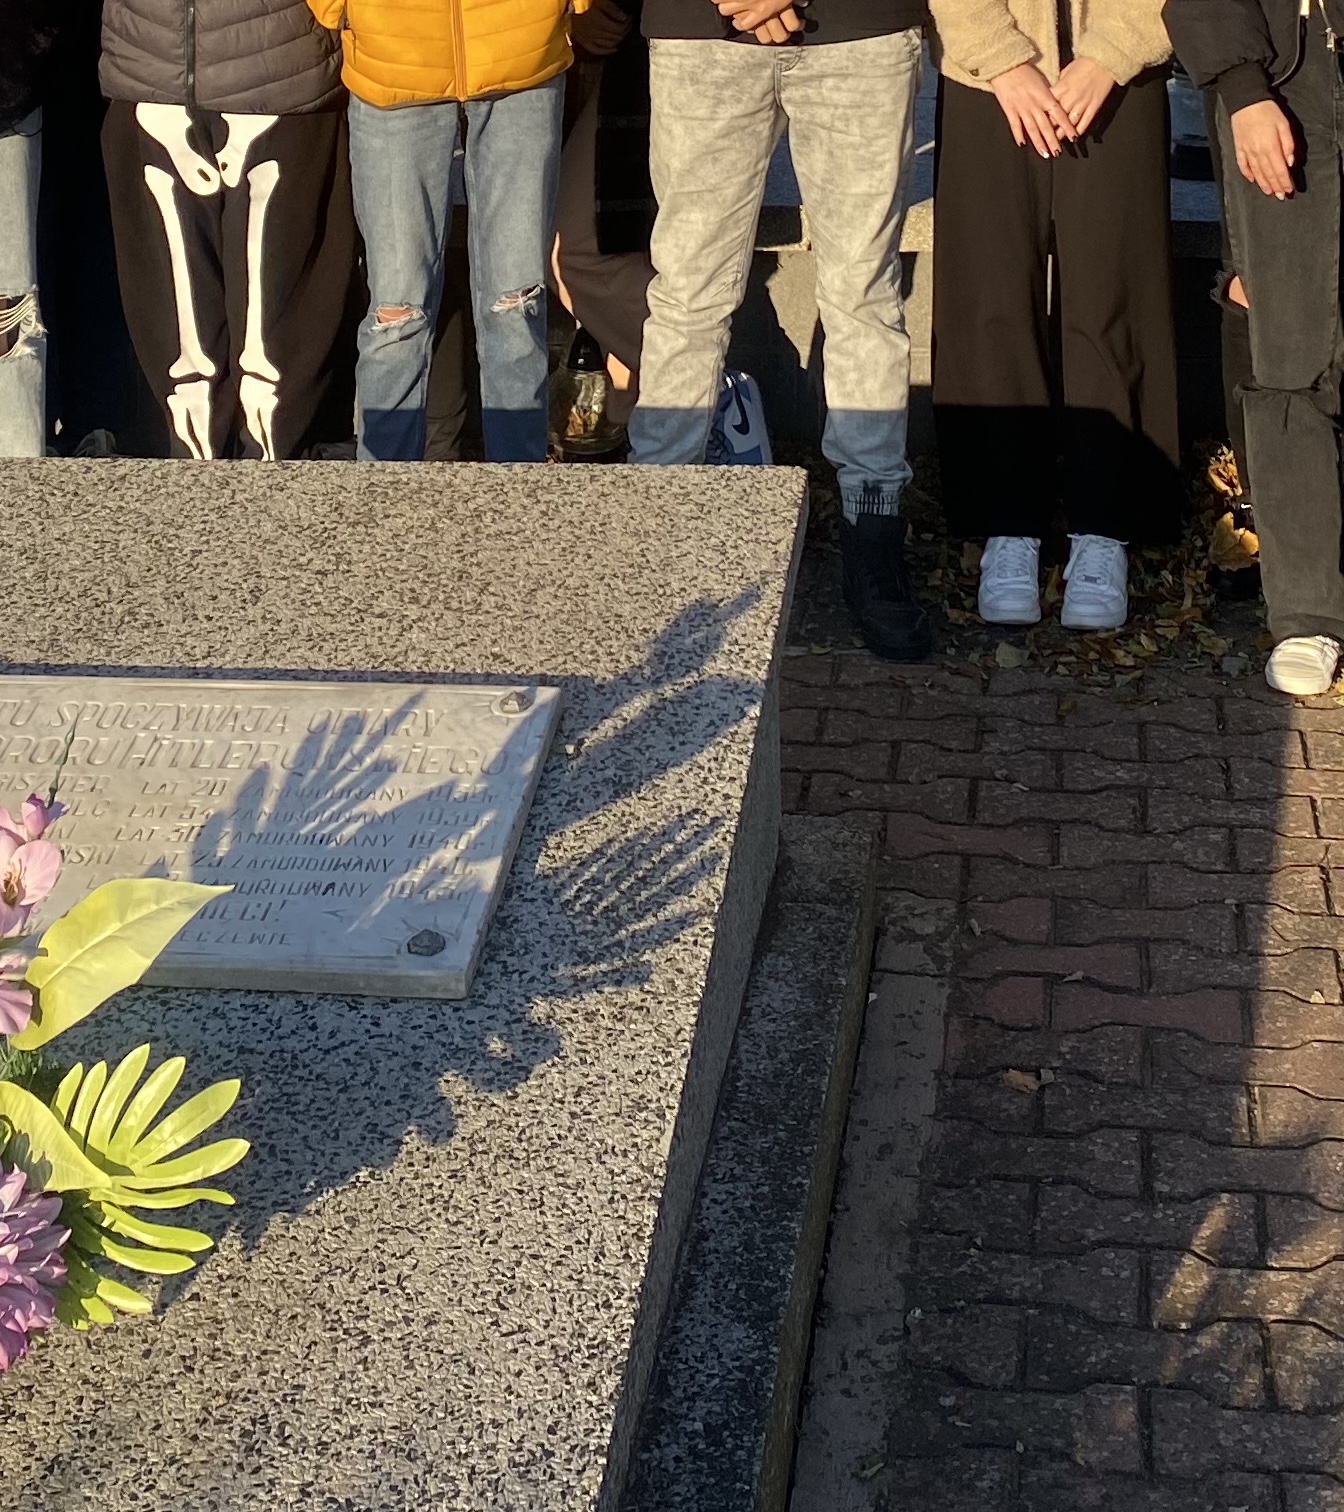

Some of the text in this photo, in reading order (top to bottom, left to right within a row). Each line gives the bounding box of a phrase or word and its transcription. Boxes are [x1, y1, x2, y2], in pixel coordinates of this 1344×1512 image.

[141, 780, 186, 796] LAT
[128, 802, 174, 818] LAT
[114, 825, 161, 842] LAT
[139, 849, 186, 867] LAT
[178, 928, 296, 947] ECZEWIE
